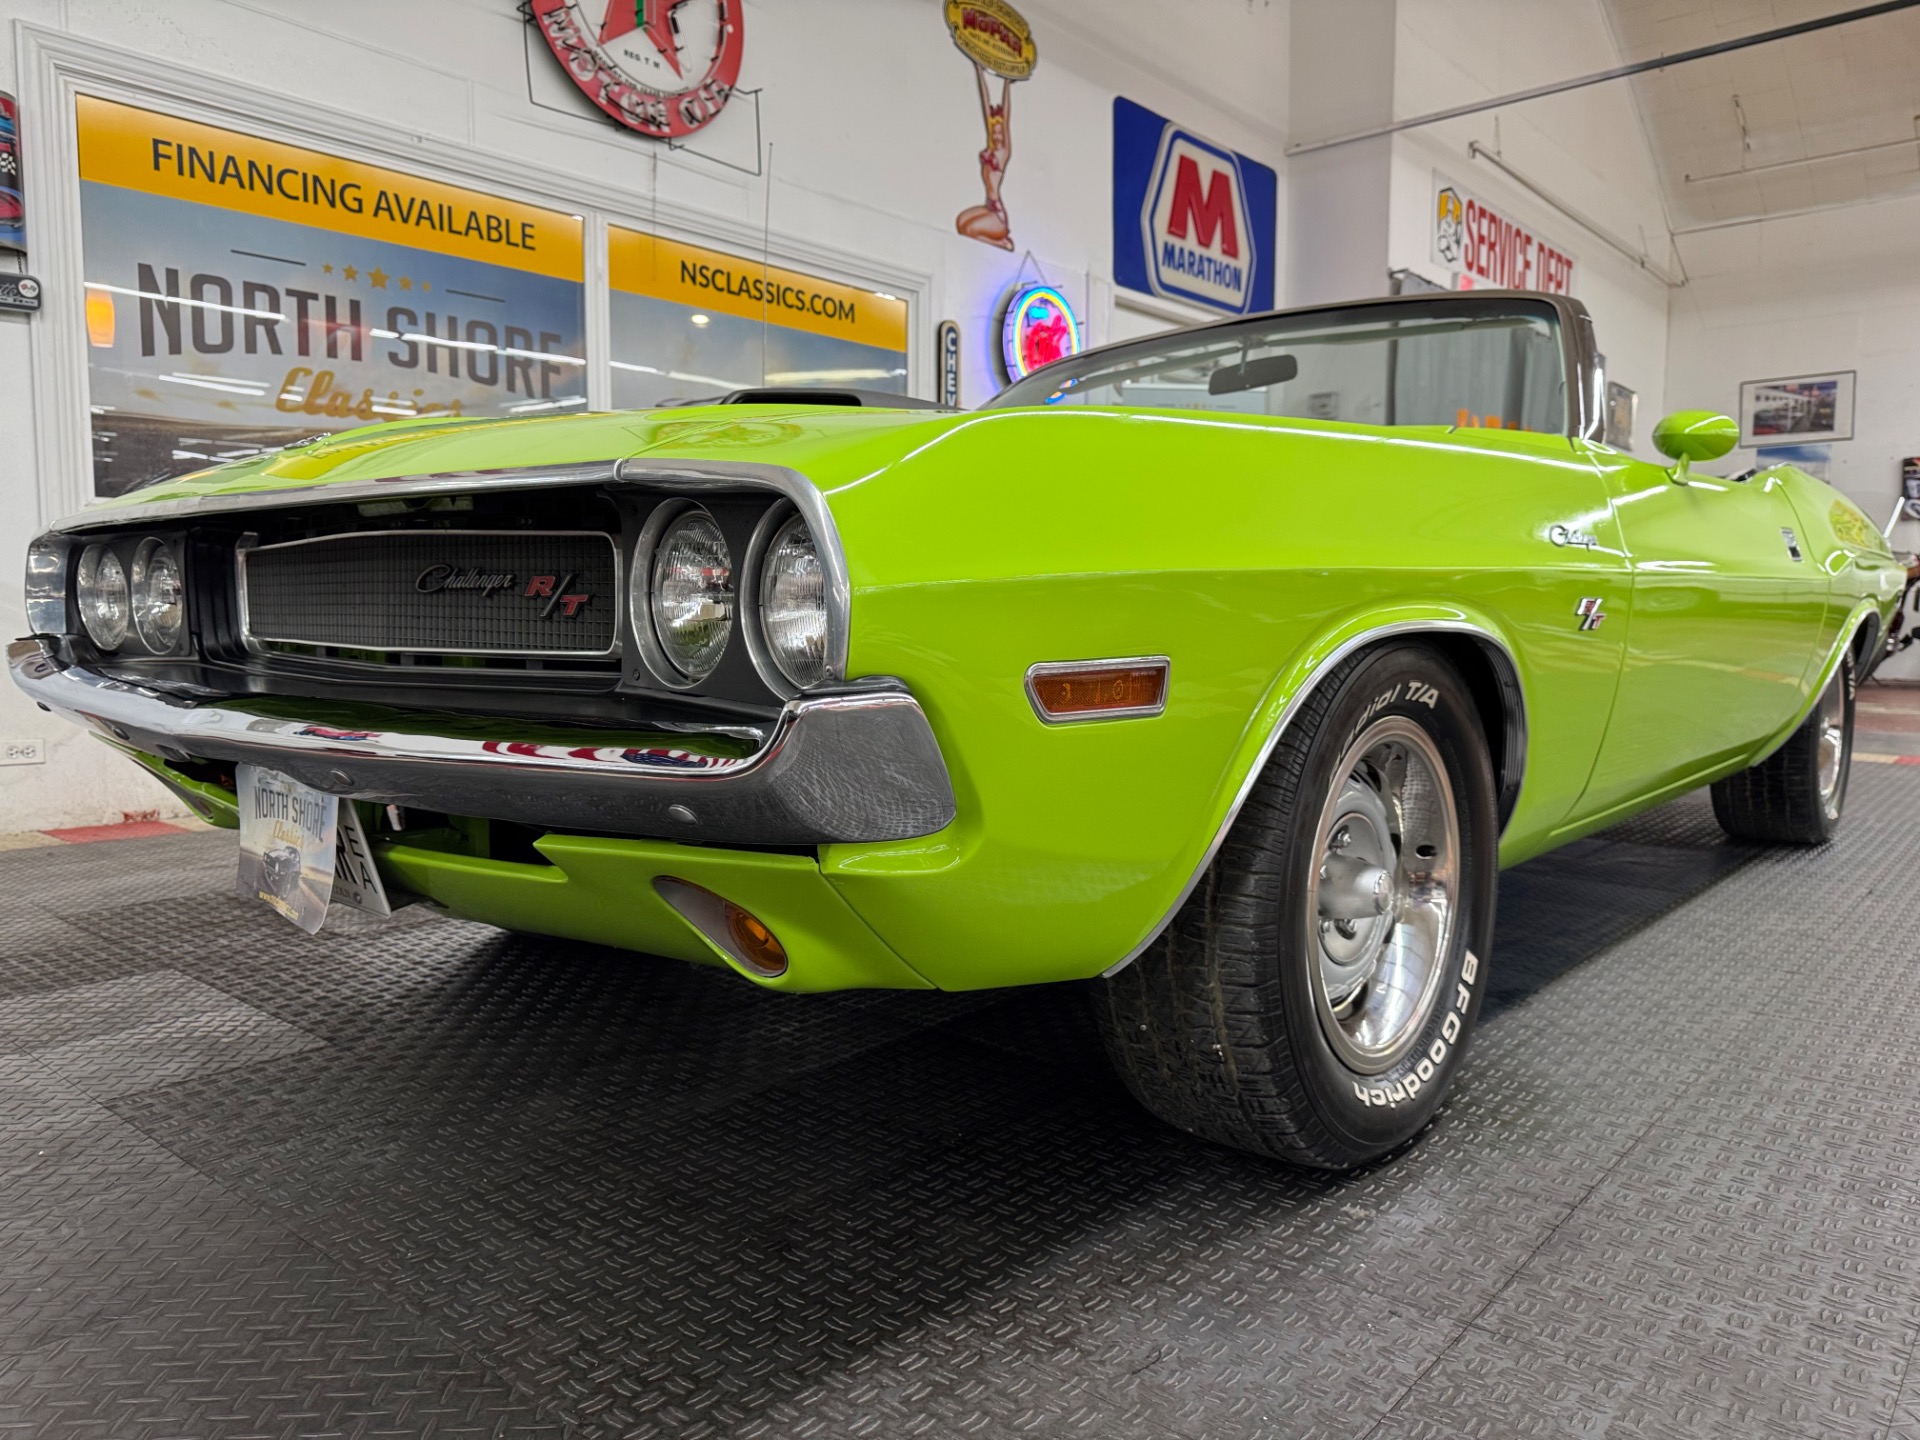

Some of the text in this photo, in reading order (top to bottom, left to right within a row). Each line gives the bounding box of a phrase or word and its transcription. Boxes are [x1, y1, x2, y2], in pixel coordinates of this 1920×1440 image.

[152, 138, 536, 251] FINANCING AVAILABLE
[1162, 241, 1242, 292] MARATHON
[1464, 198, 1533, 290] SERVICE
[680, 259, 855, 324] NSCLASSICS.COM
[137, 262, 562, 402] NORTH SHORE
[415, 564, 589, 617] Challenger R/T
[1404, 681, 1440, 710] T/A
[254, 786, 328, 843] NORTH SHORE
[1352, 950, 1480, 1109] BFGoodrich
